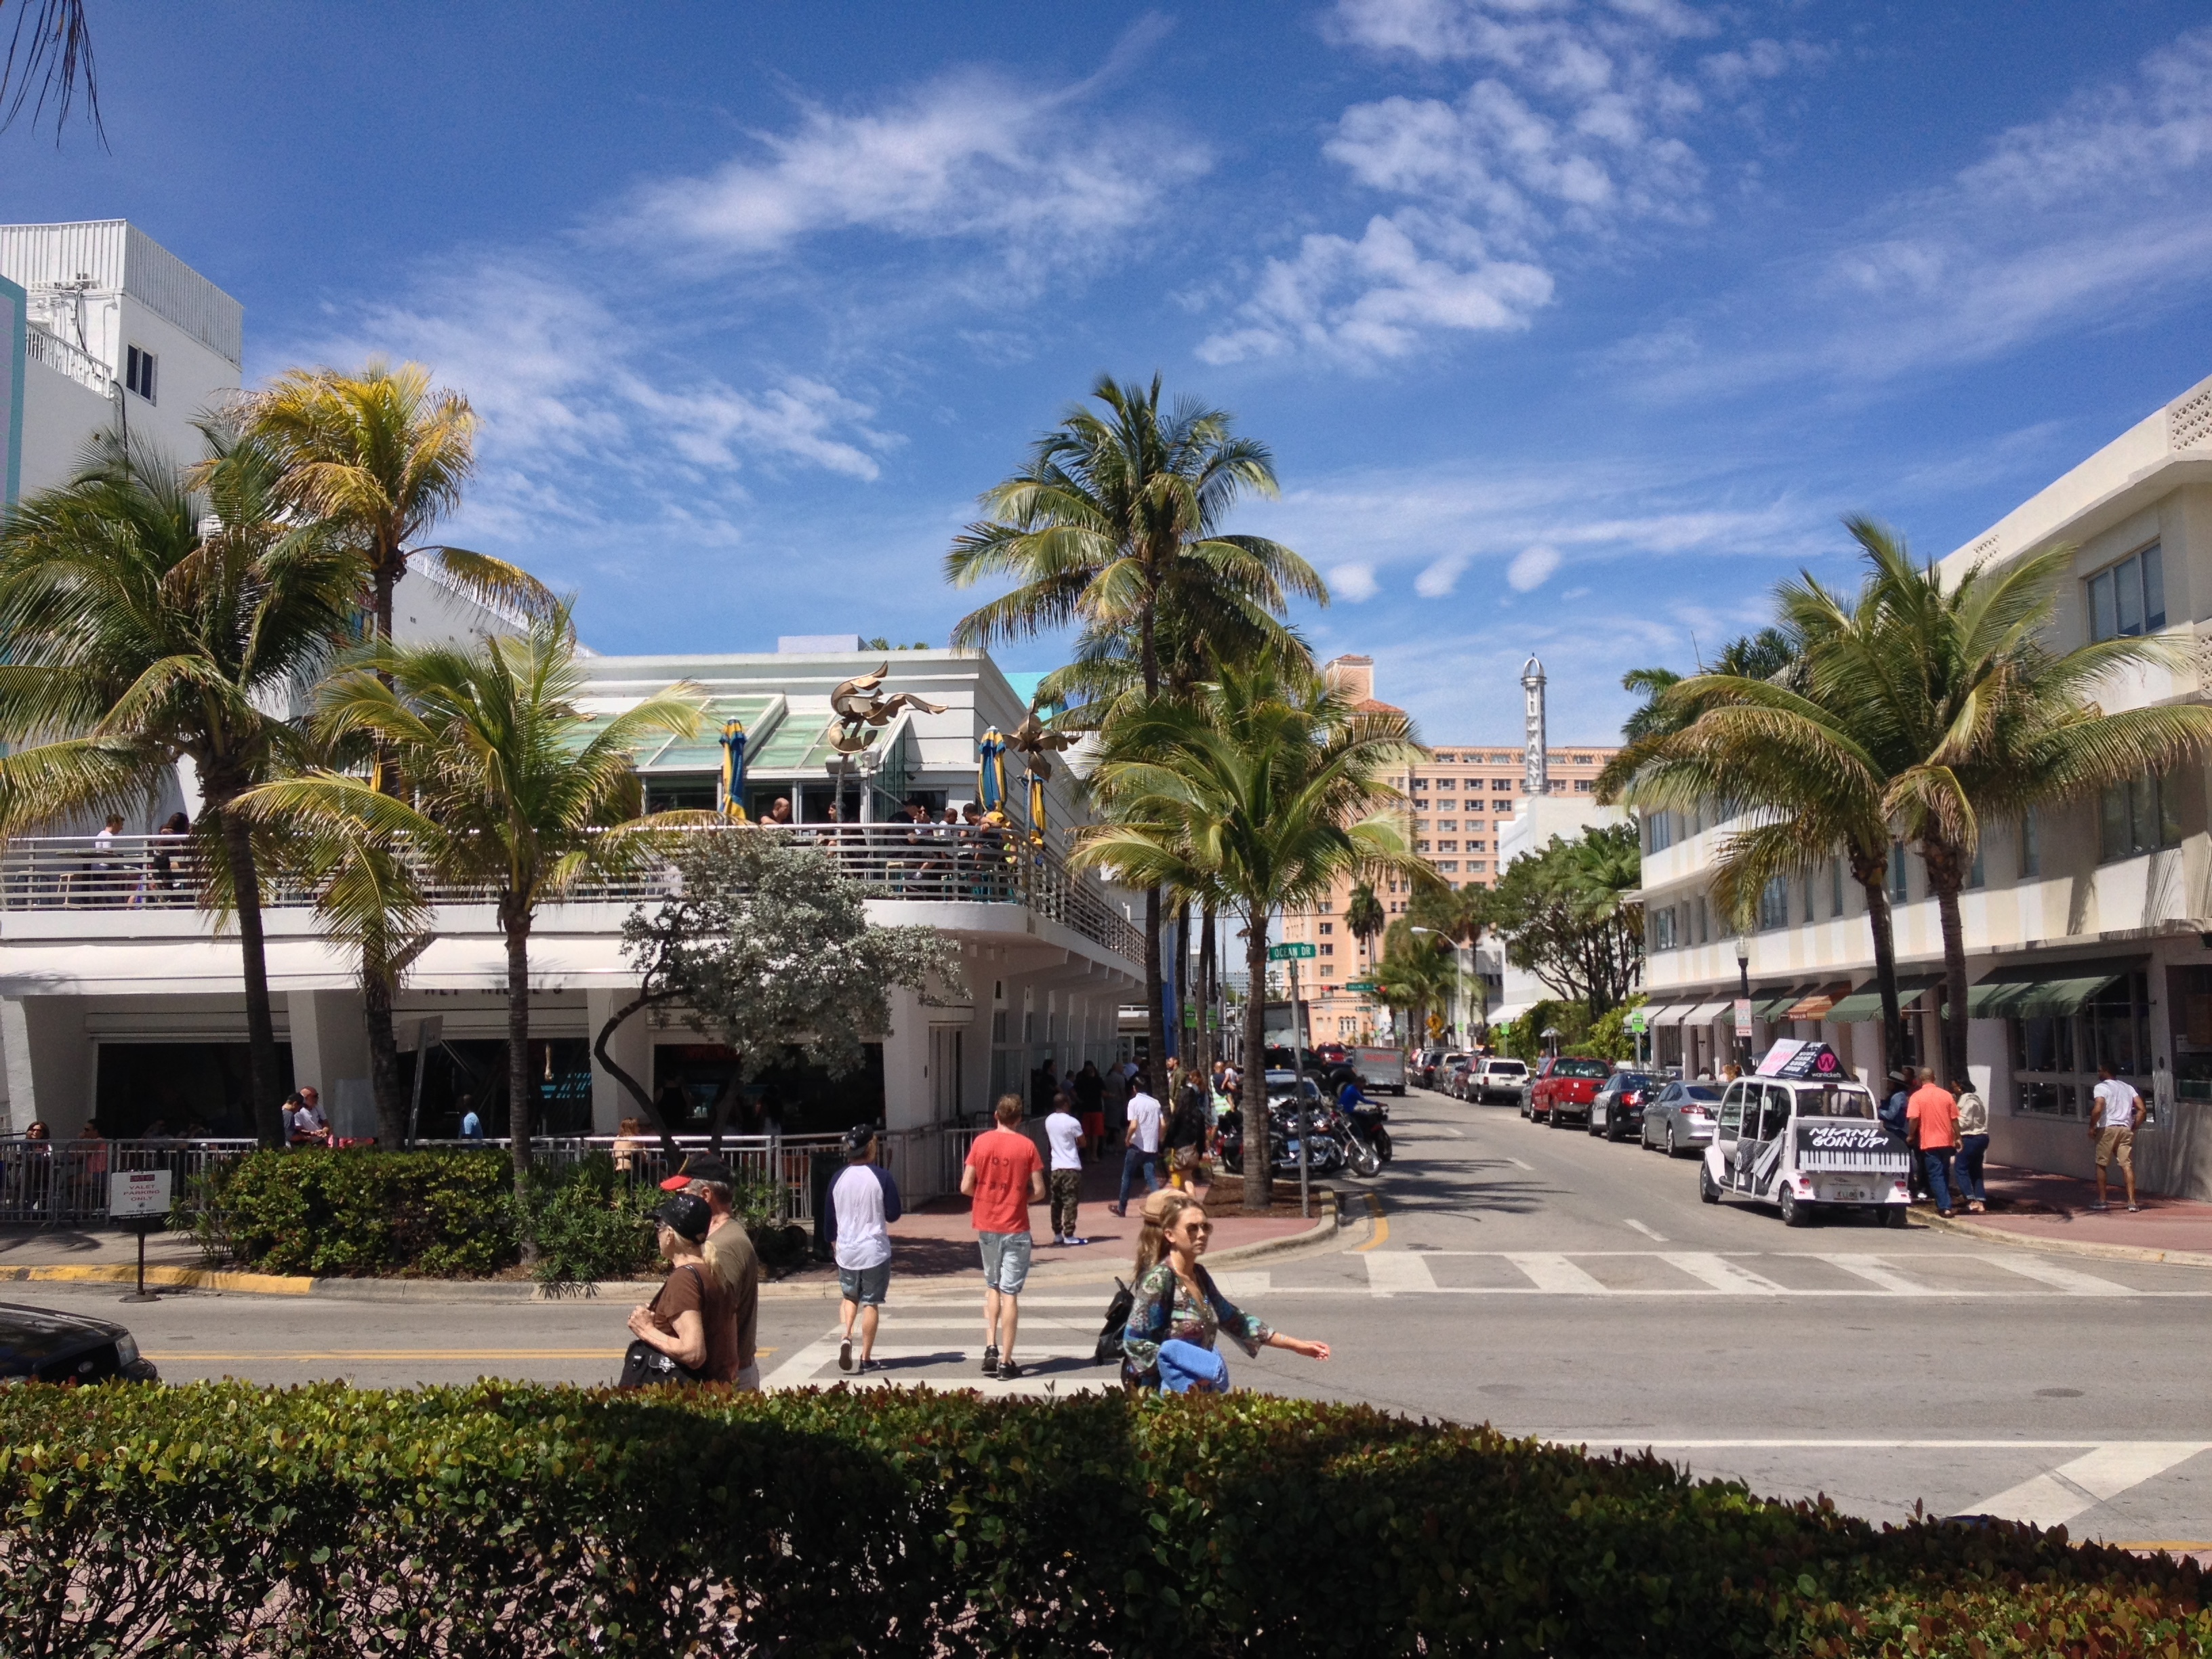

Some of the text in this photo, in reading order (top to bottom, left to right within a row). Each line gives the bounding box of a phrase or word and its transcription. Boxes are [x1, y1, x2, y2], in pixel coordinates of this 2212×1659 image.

[1526, 687, 1540, 786] TIFFANY
[1274, 946, 1311, 958] OCEAN DR
[1809, 1127, 1878, 1138] MIAMI
[1812, 1136, 1889, 1148] GOIN' UP!
